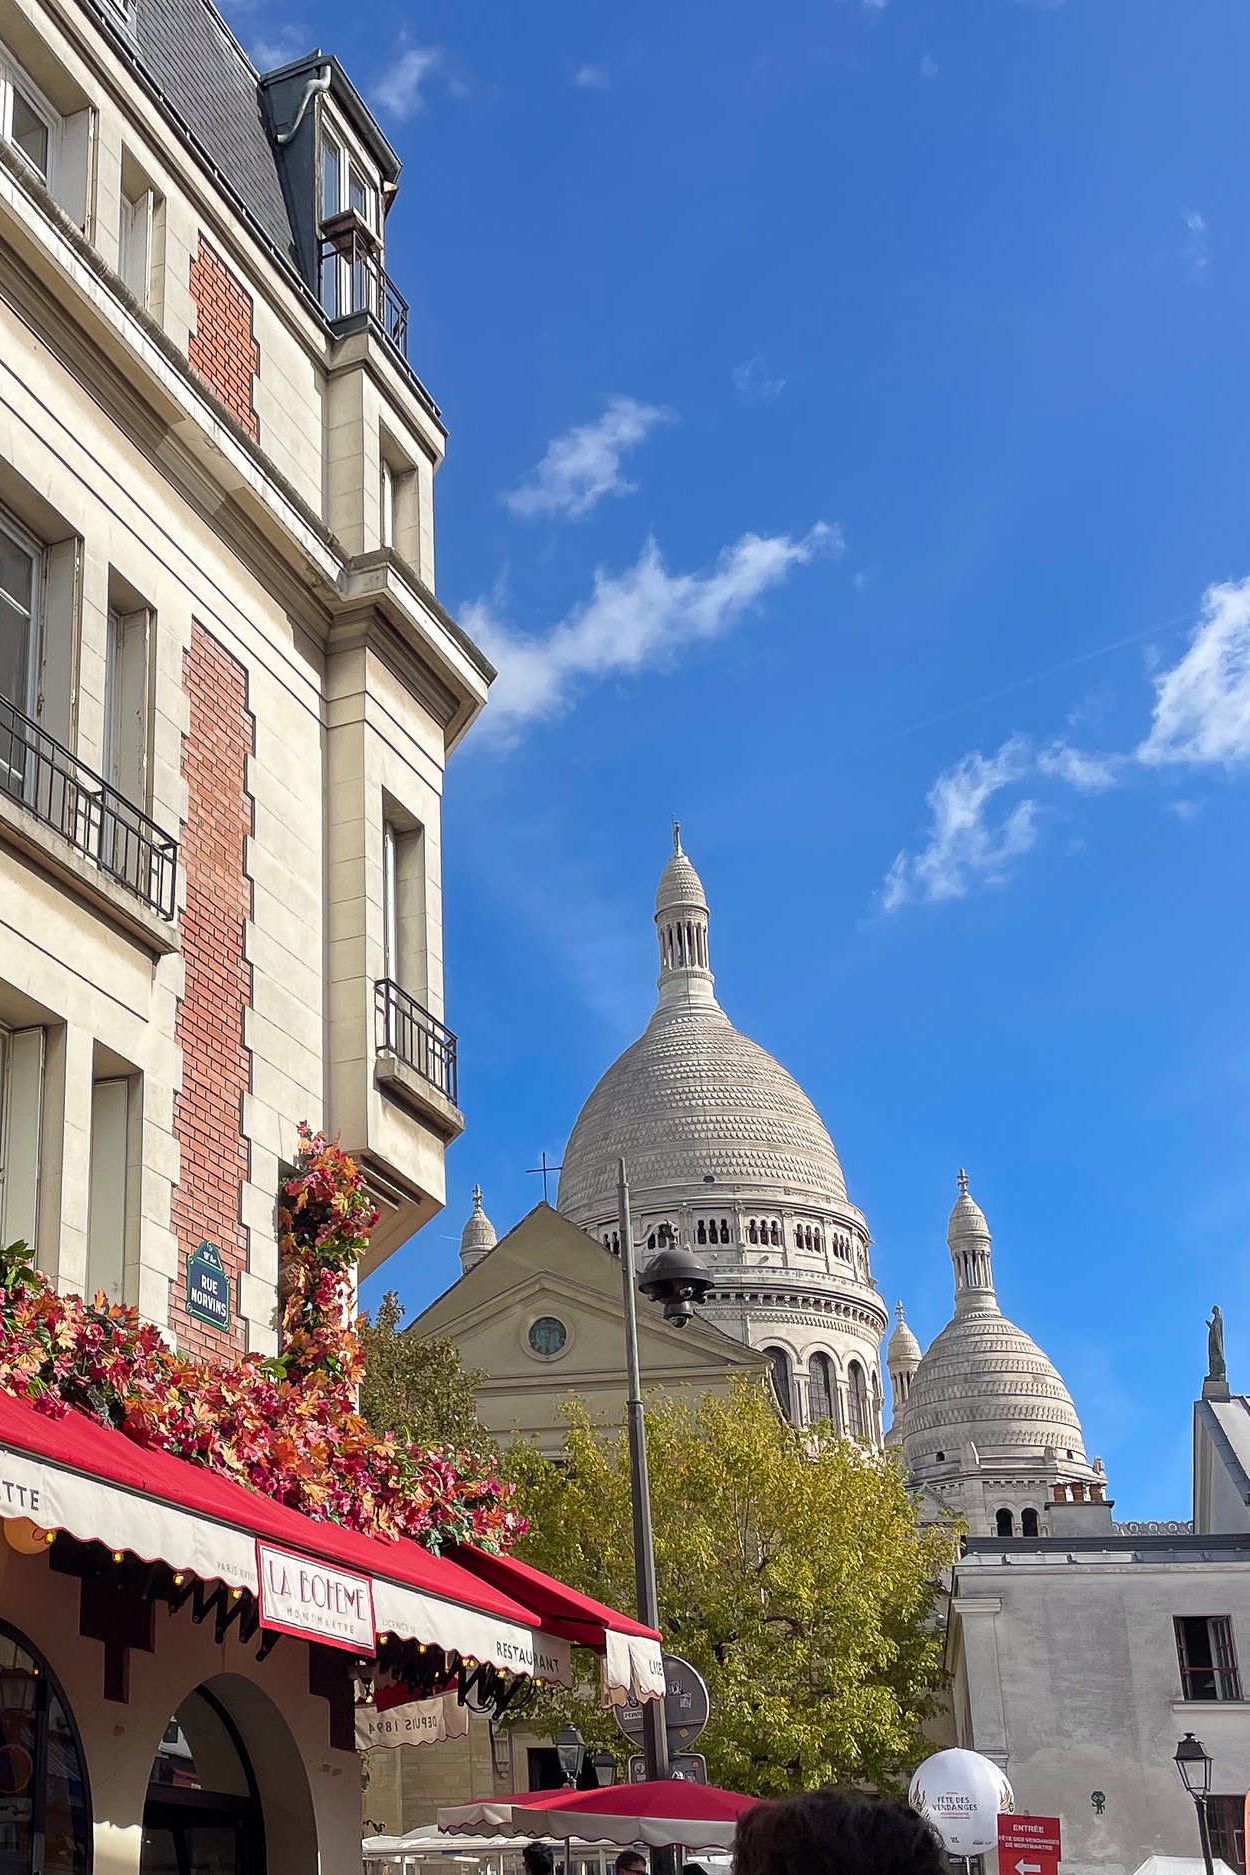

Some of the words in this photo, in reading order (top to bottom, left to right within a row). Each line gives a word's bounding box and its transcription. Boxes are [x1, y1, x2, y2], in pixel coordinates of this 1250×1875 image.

[201, 1275, 218, 1295] RUE
[191, 1287, 227, 1318] NORVINS
[217, 1560, 238, 1576] PARIS
[269, 1560, 292, 1596] LA
[286, 1607, 355, 1635] MONTMARTRE
[382, 1616, 409, 1632] LICENCE
[496, 1640, 560, 1674] RESTAURANT
[932, 1803, 978, 1811] VENDANGES
[956, 1796, 970, 1804] DES
[1013, 1824, 1044, 1833] ENTRÉE
